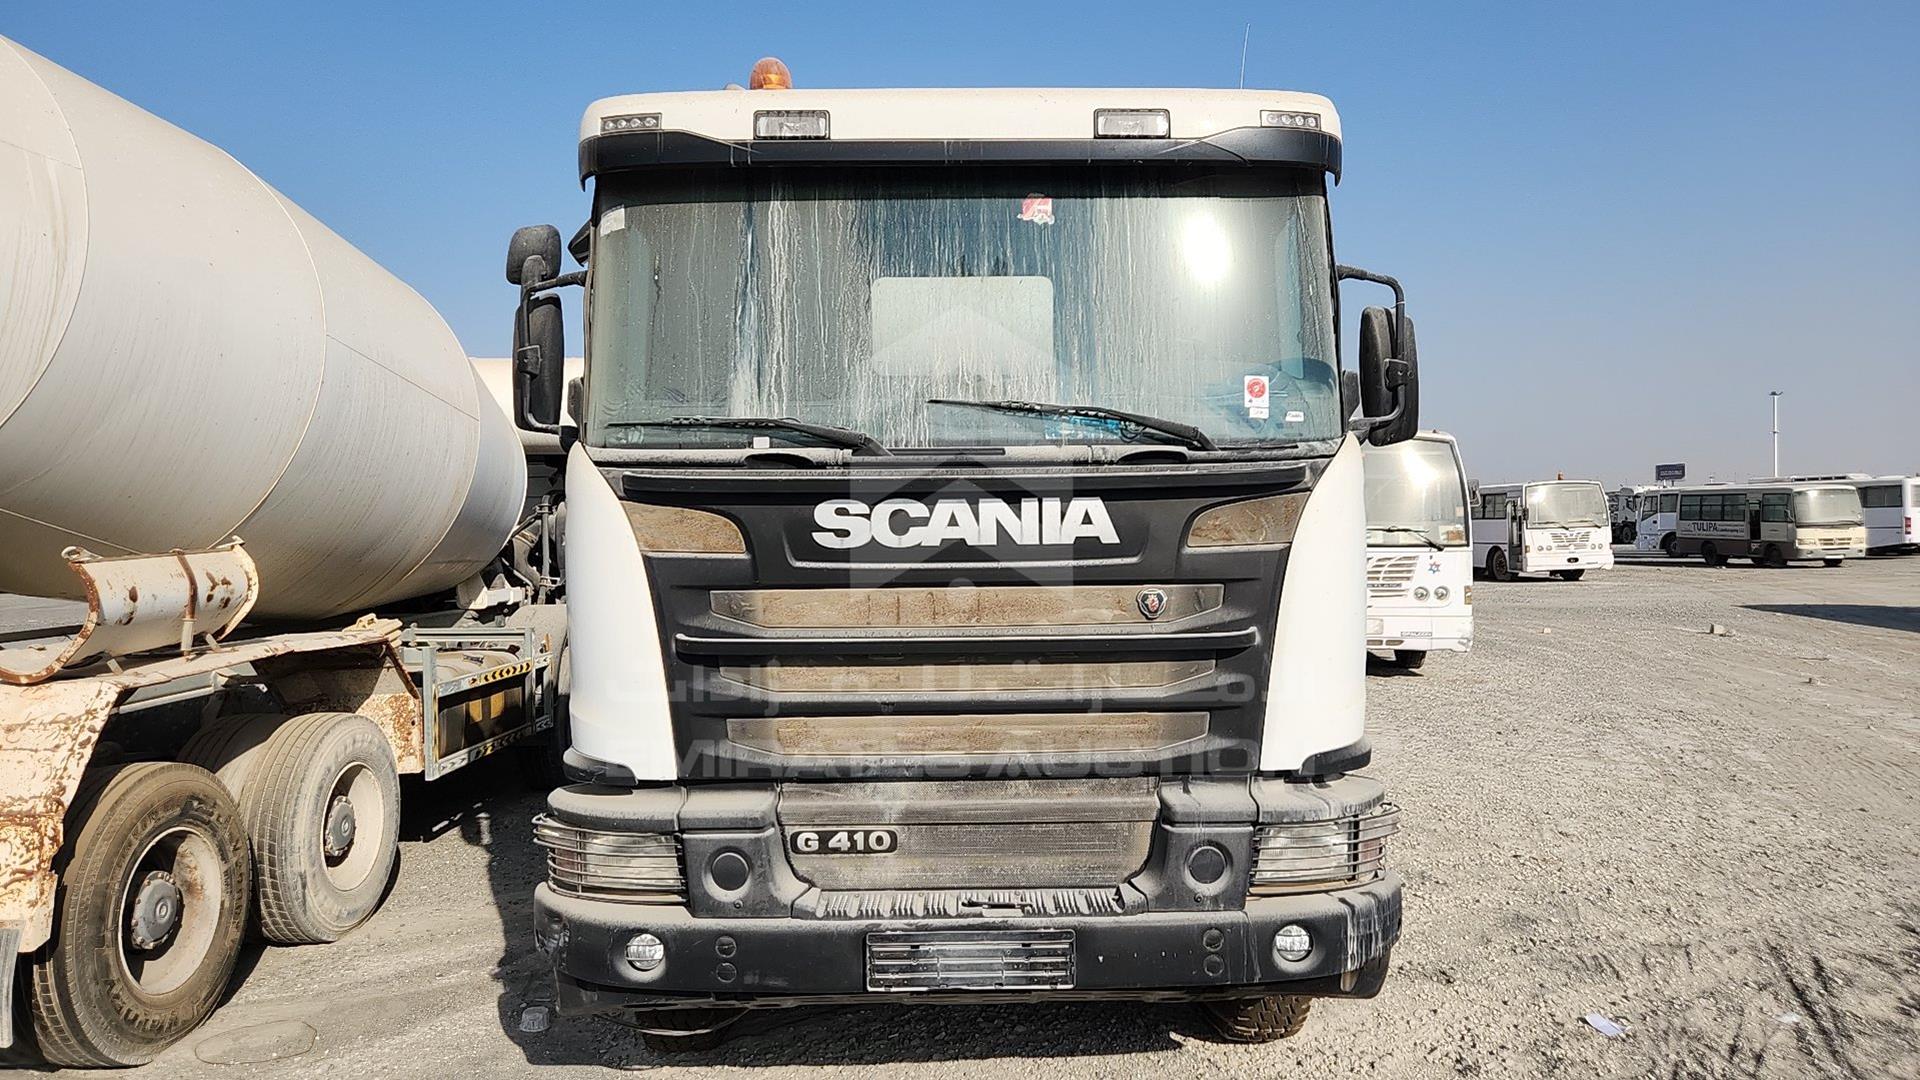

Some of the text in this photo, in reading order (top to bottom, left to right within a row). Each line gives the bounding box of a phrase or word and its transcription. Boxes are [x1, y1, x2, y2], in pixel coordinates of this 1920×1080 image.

[811, 497, 1120, 549] SCANIA
[1692, 522, 1717, 532] TULIPA
[796, 830, 892, 852] G 410
